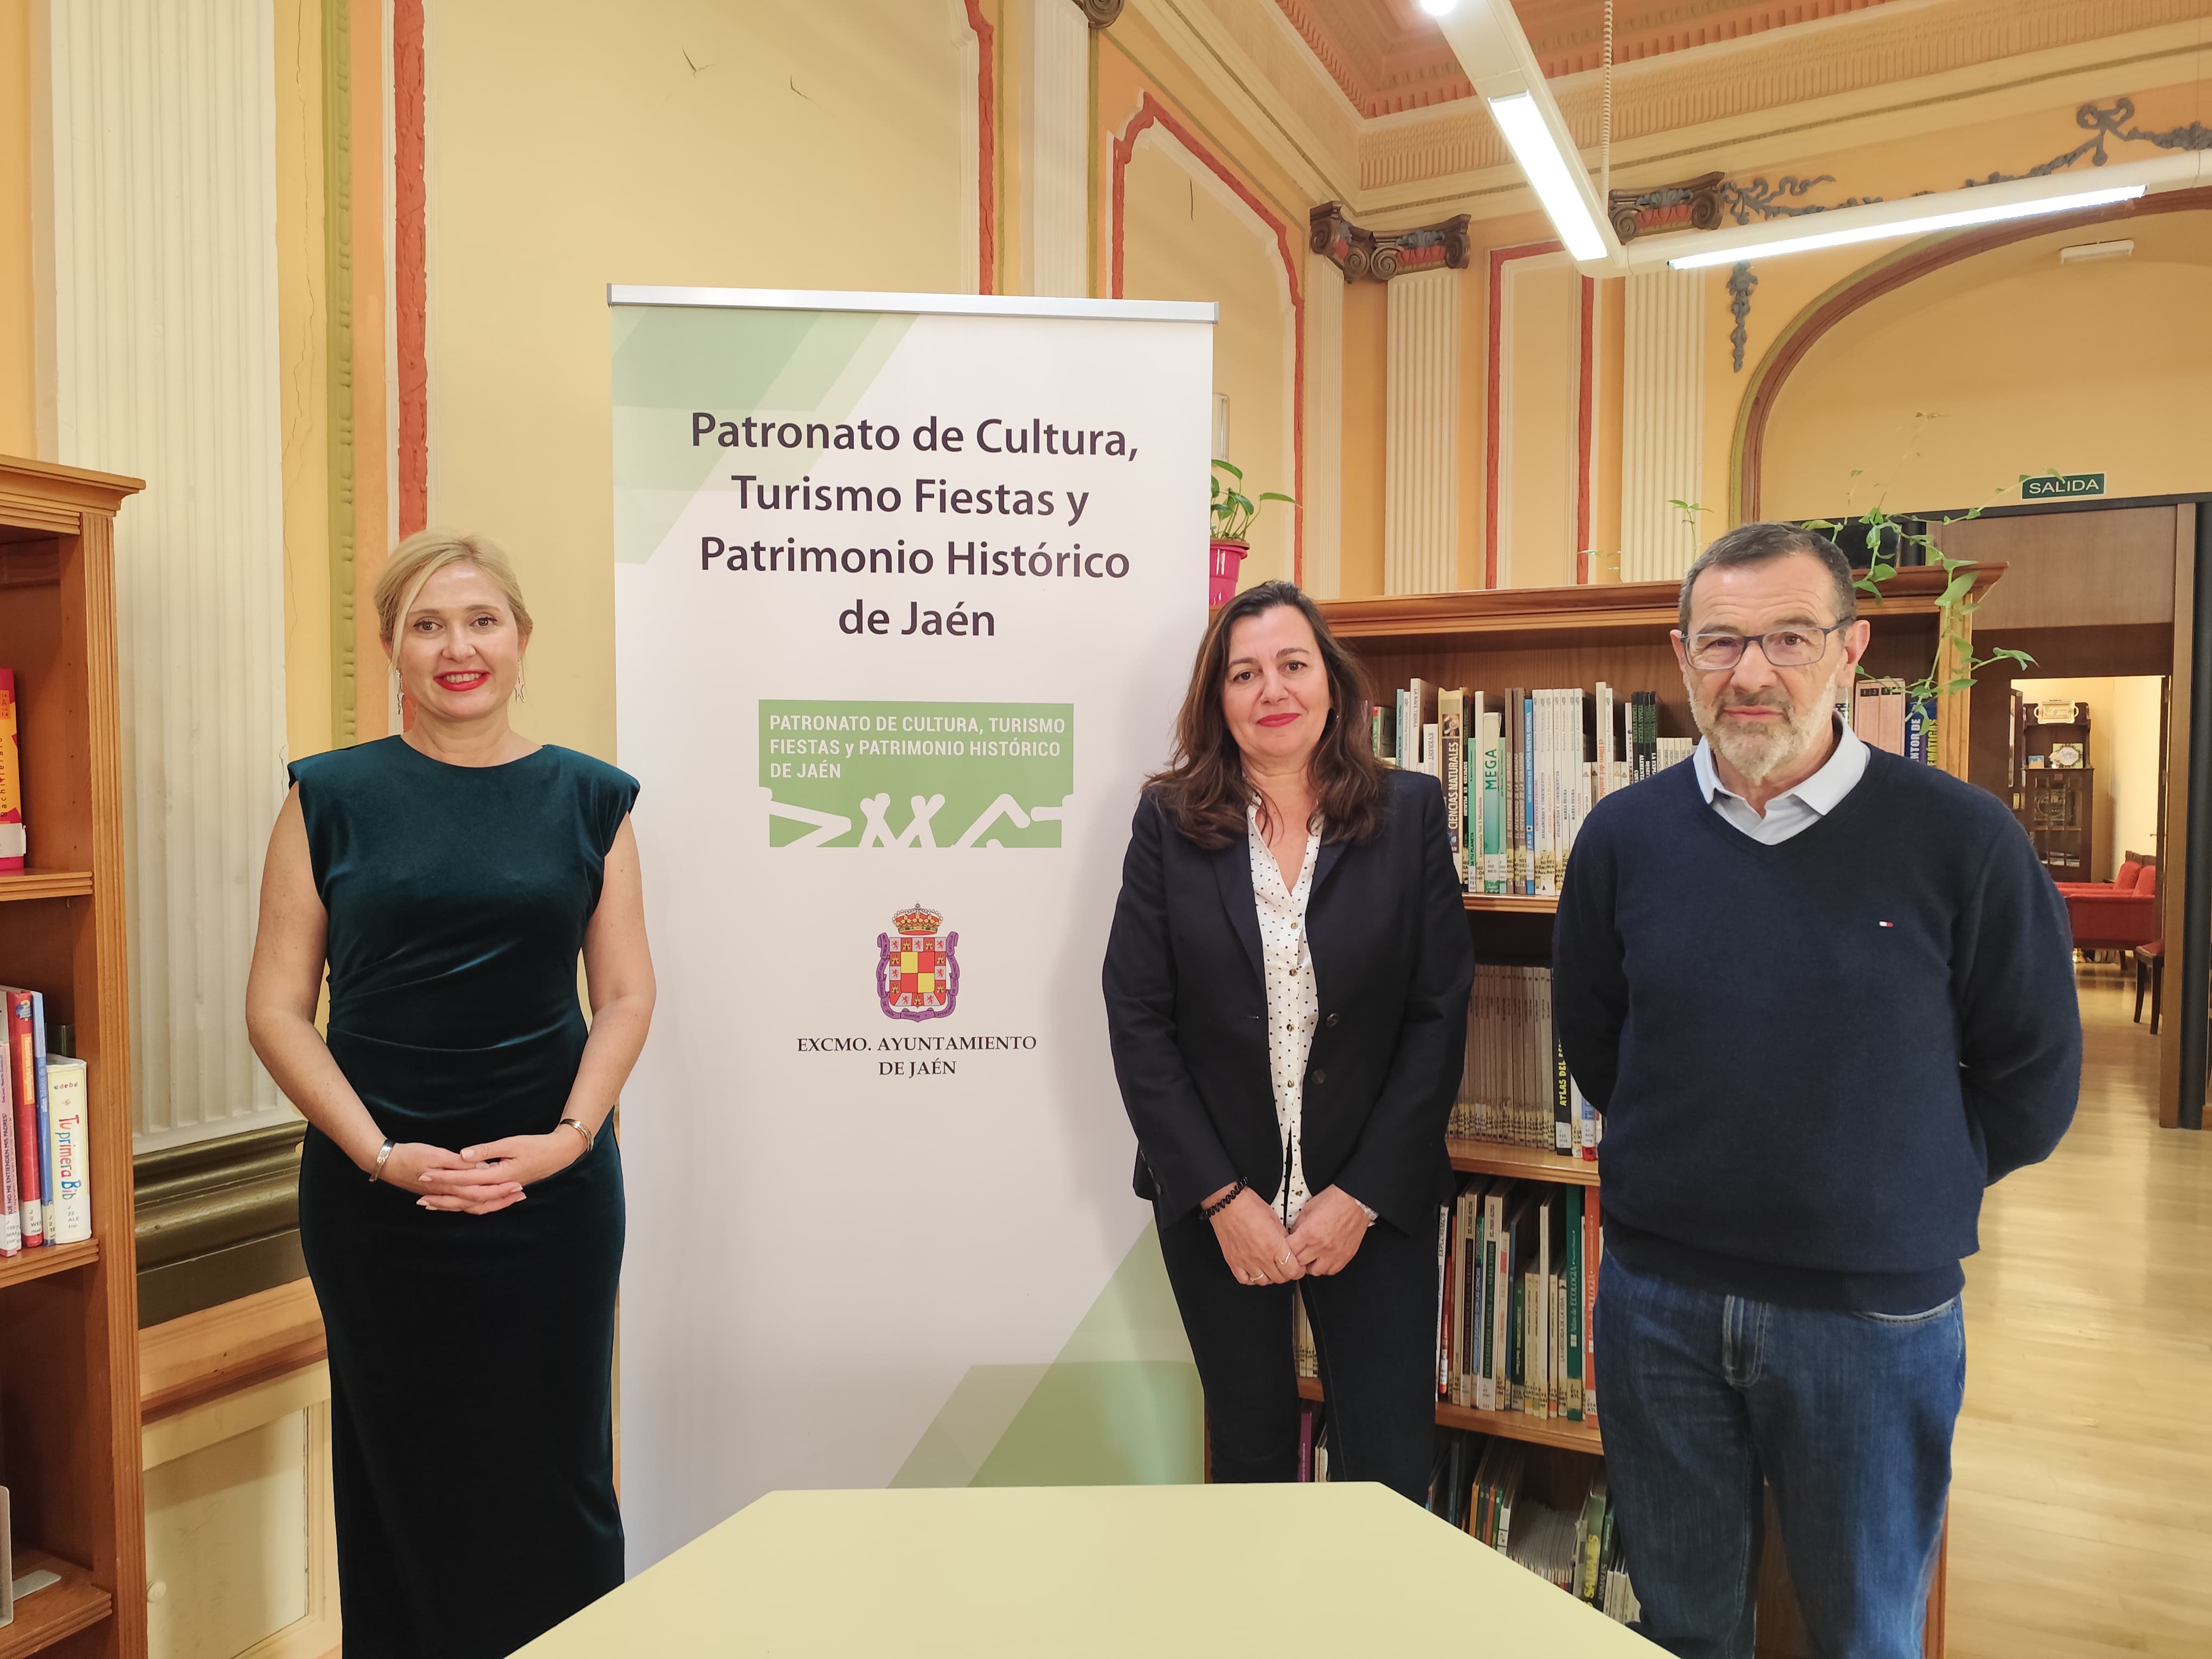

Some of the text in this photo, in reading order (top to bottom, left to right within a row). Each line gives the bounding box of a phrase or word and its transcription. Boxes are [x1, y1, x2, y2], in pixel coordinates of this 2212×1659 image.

[691, 412, 1139, 461] Patronato de Cultura,
[2028, 478, 2099, 494] SALIDA
[731, 475, 1090, 526] Turismo Fiestas y
[701, 536, 1130, 579] Patrimonio Histórico
[839, 599, 996, 636] de Jaén
[770, 715, 1065, 736] PATRONATO DE CULTURA, TURISMO
[1911, 719, 1921, 731] DE
[770, 737, 1061, 759] FIESTAS y PATRIMONIO HISTÓRICO
[770, 759, 841, 780] DE JAÉN
[1484, 748, 1497, 790] MEGA
[1448, 742, 1459, 829] CIENCIAS NATURALES
[797, 1036, 1037, 1052] EXCMO. AYUNTAMIENTO
[879, 1058, 957, 1079] DE JAÉN
[1558, 1060, 1566, 1077] DEL
[54, 1082, 78, 1090] edebé
[1558, 1079, 1567, 1106] ATLAS
[55, 1114, 81, 1200] Tu primera Bib
[7, 1184, 12, 1193] ME
[7, 1194, 12, 1204] NO
[1438, 1212, 1446, 1257] EXPLOREMOS
[1584, 1534, 1599, 1598] SALVAJES
[1598, 1564, 1607, 1601] ANIMALES
